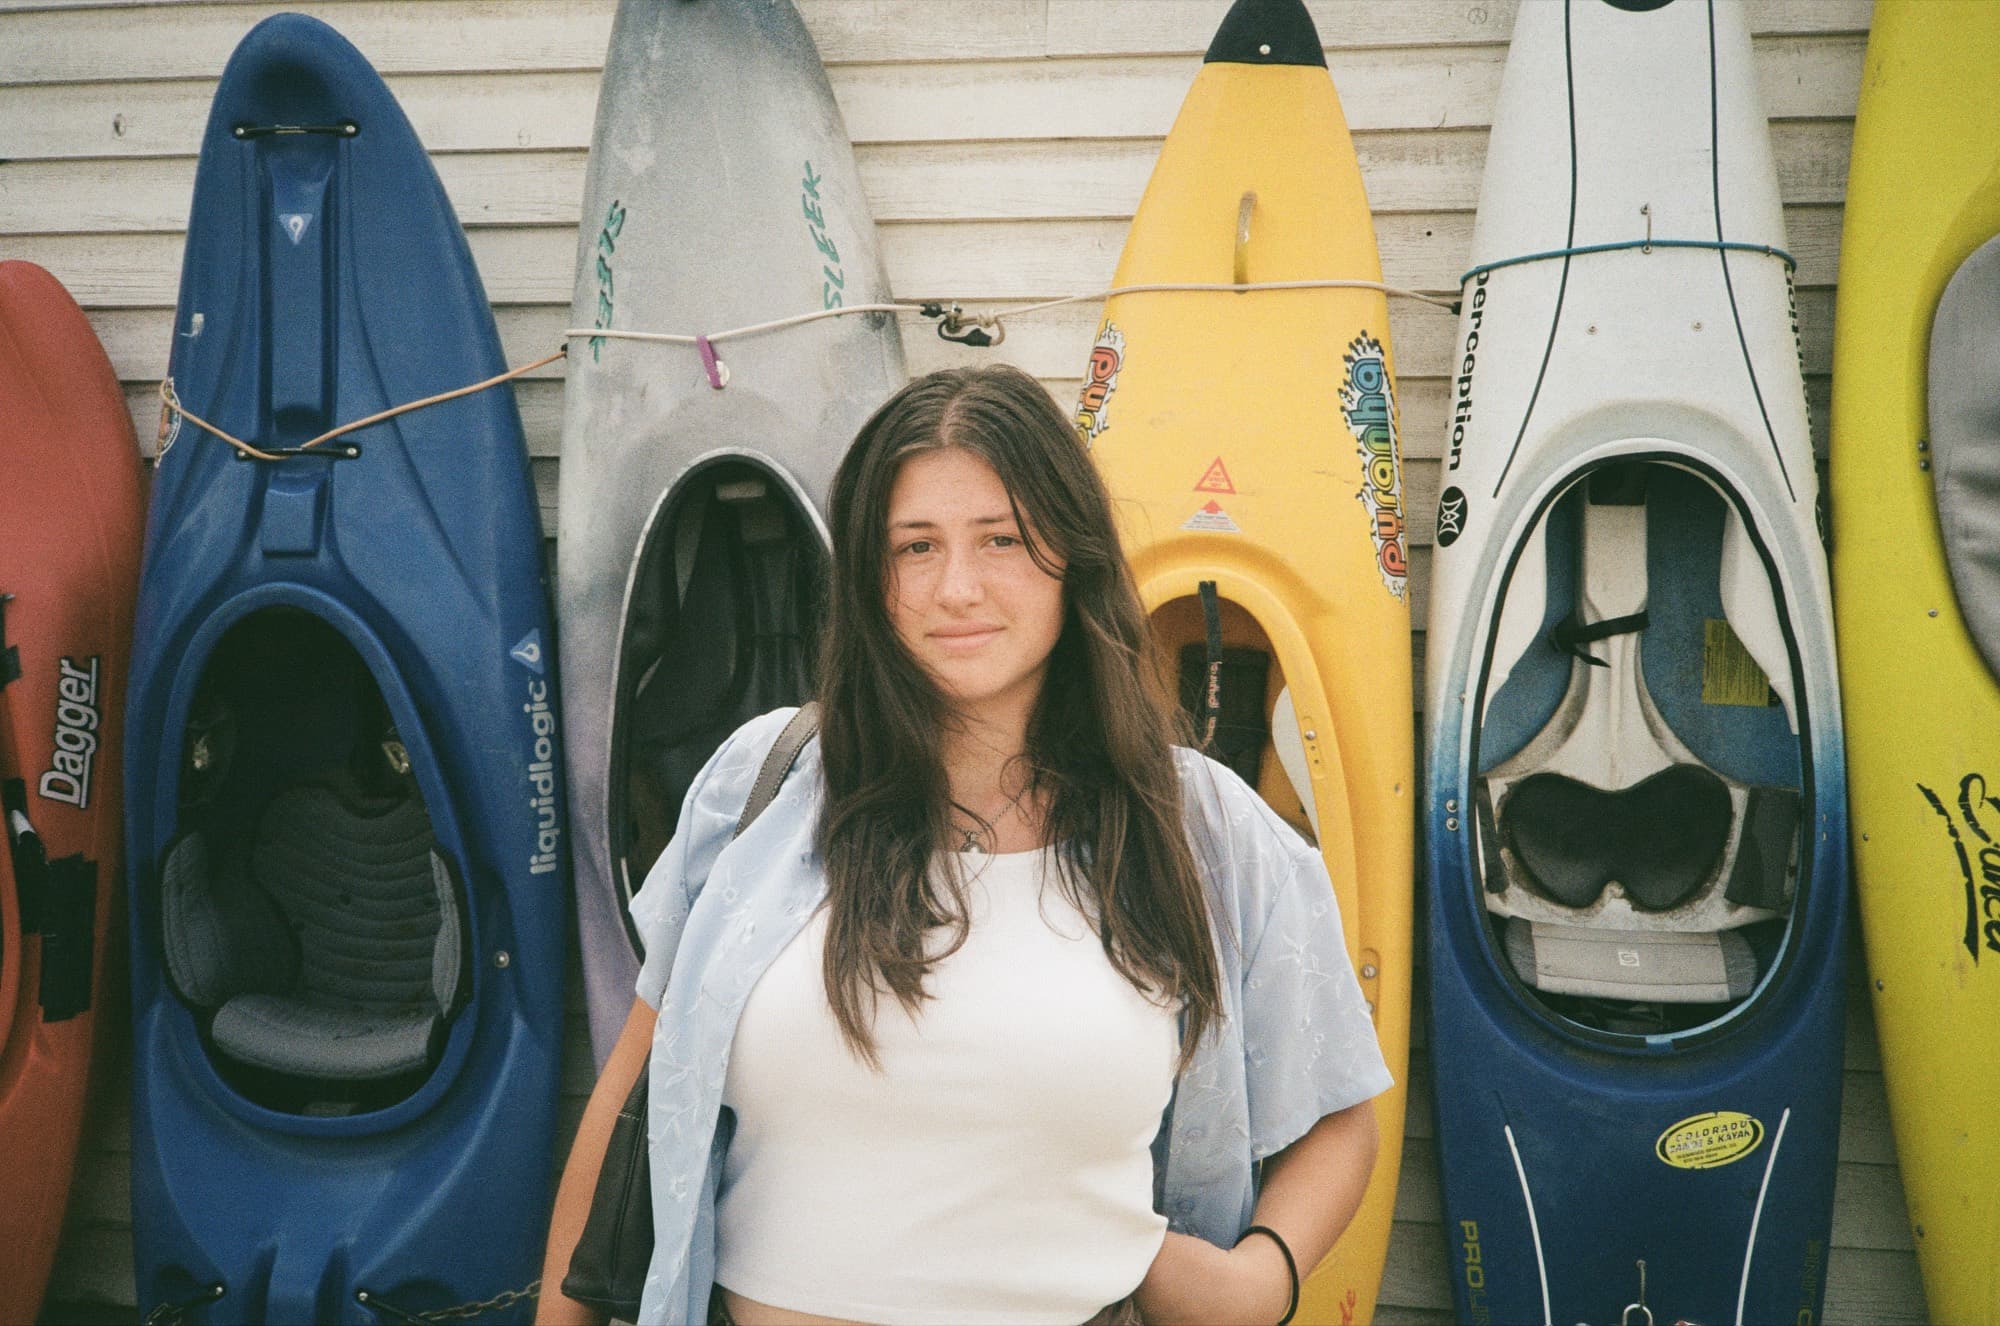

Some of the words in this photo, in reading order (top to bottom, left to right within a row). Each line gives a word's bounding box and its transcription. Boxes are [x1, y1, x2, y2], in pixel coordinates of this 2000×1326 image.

[801, 160, 845, 319] SLEEK
[1449, 270, 1490, 471] perception
[39, 657, 99, 806] Dagger
[523, 680, 560, 875] liquidlogic
[1675, 1120, 1748, 1143] COLORADO
[1718, 1130, 1751, 1143] KAYAK
